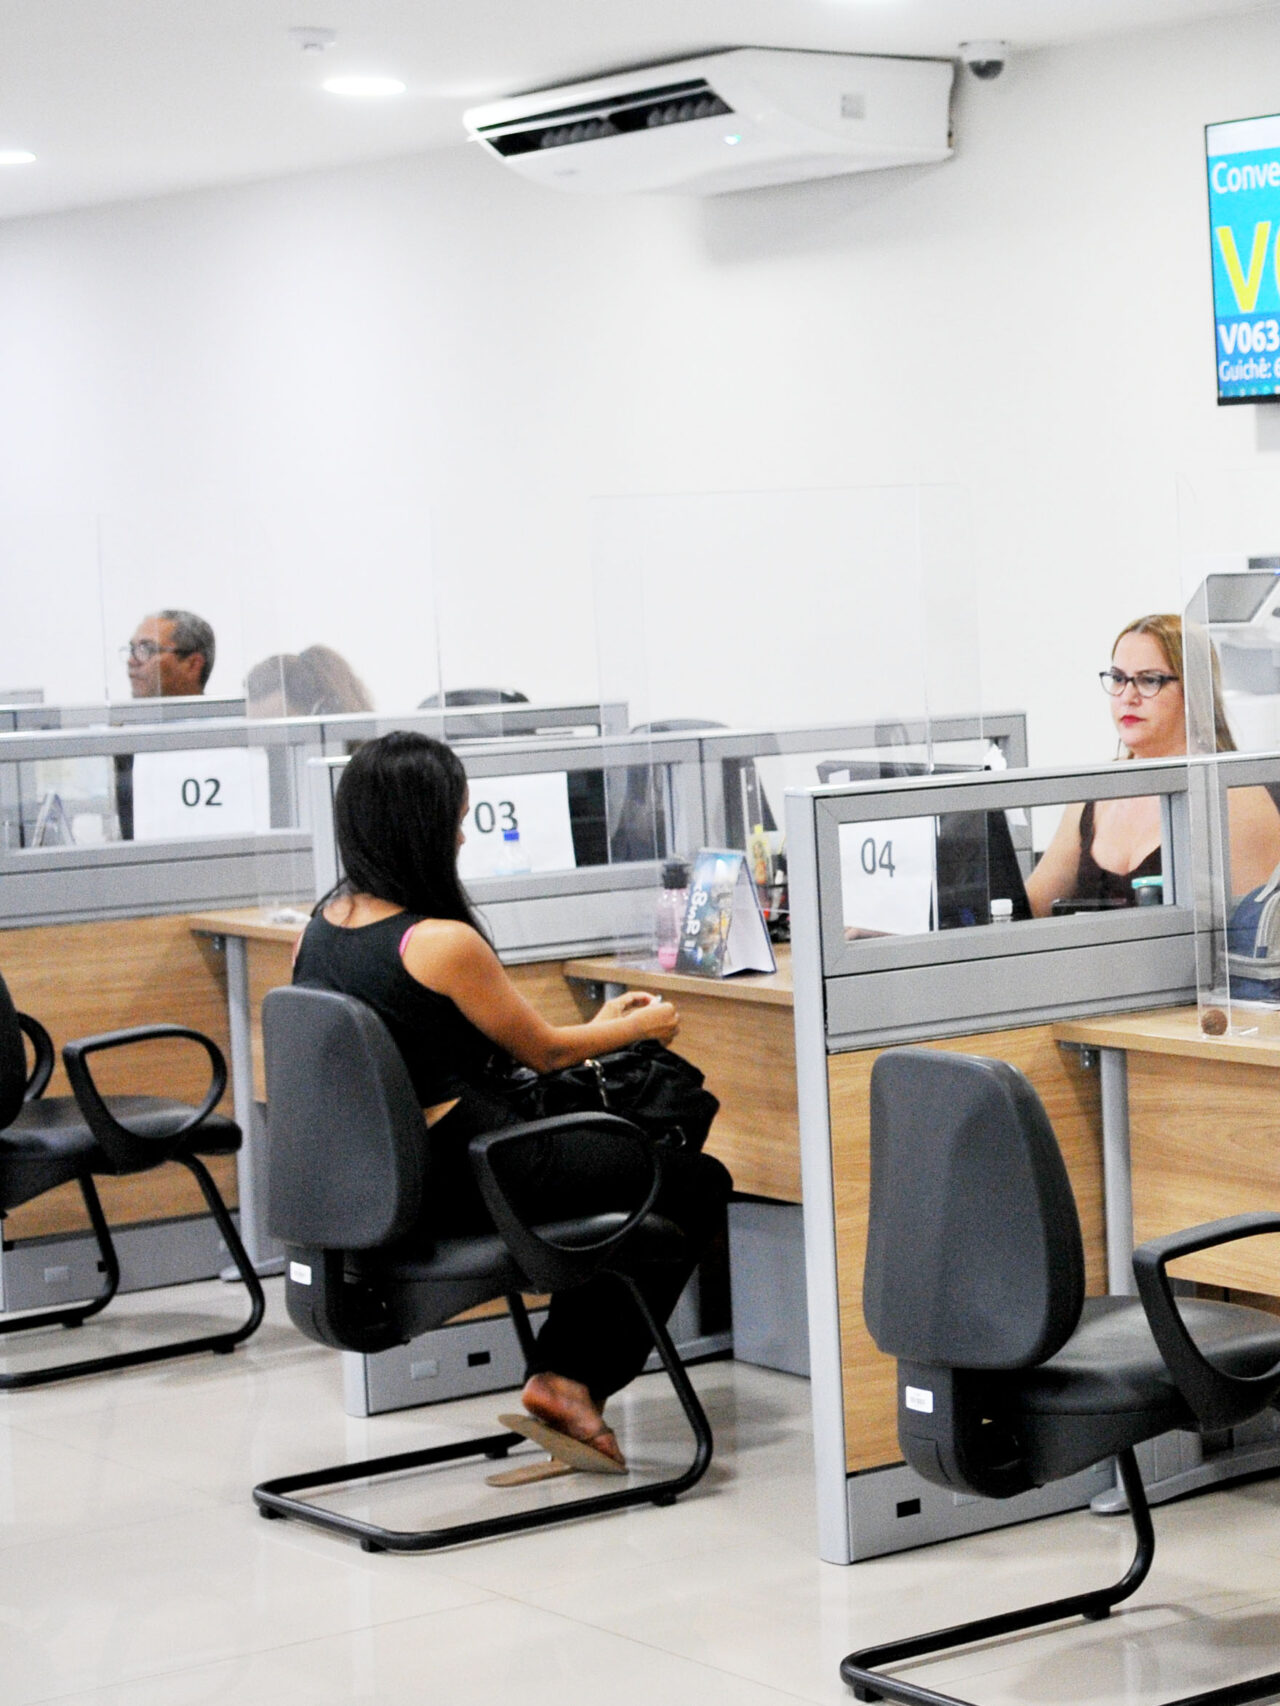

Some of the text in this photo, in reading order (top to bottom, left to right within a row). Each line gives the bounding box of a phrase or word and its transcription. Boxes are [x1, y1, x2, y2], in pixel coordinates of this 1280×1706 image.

[1218, 319, 1280, 355] V063
[1219, 356, 1272, 382] Guichê:
[181, 778, 223, 807] 02
[474, 801, 518, 834] 03
[861, 837, 896, 878] 04
